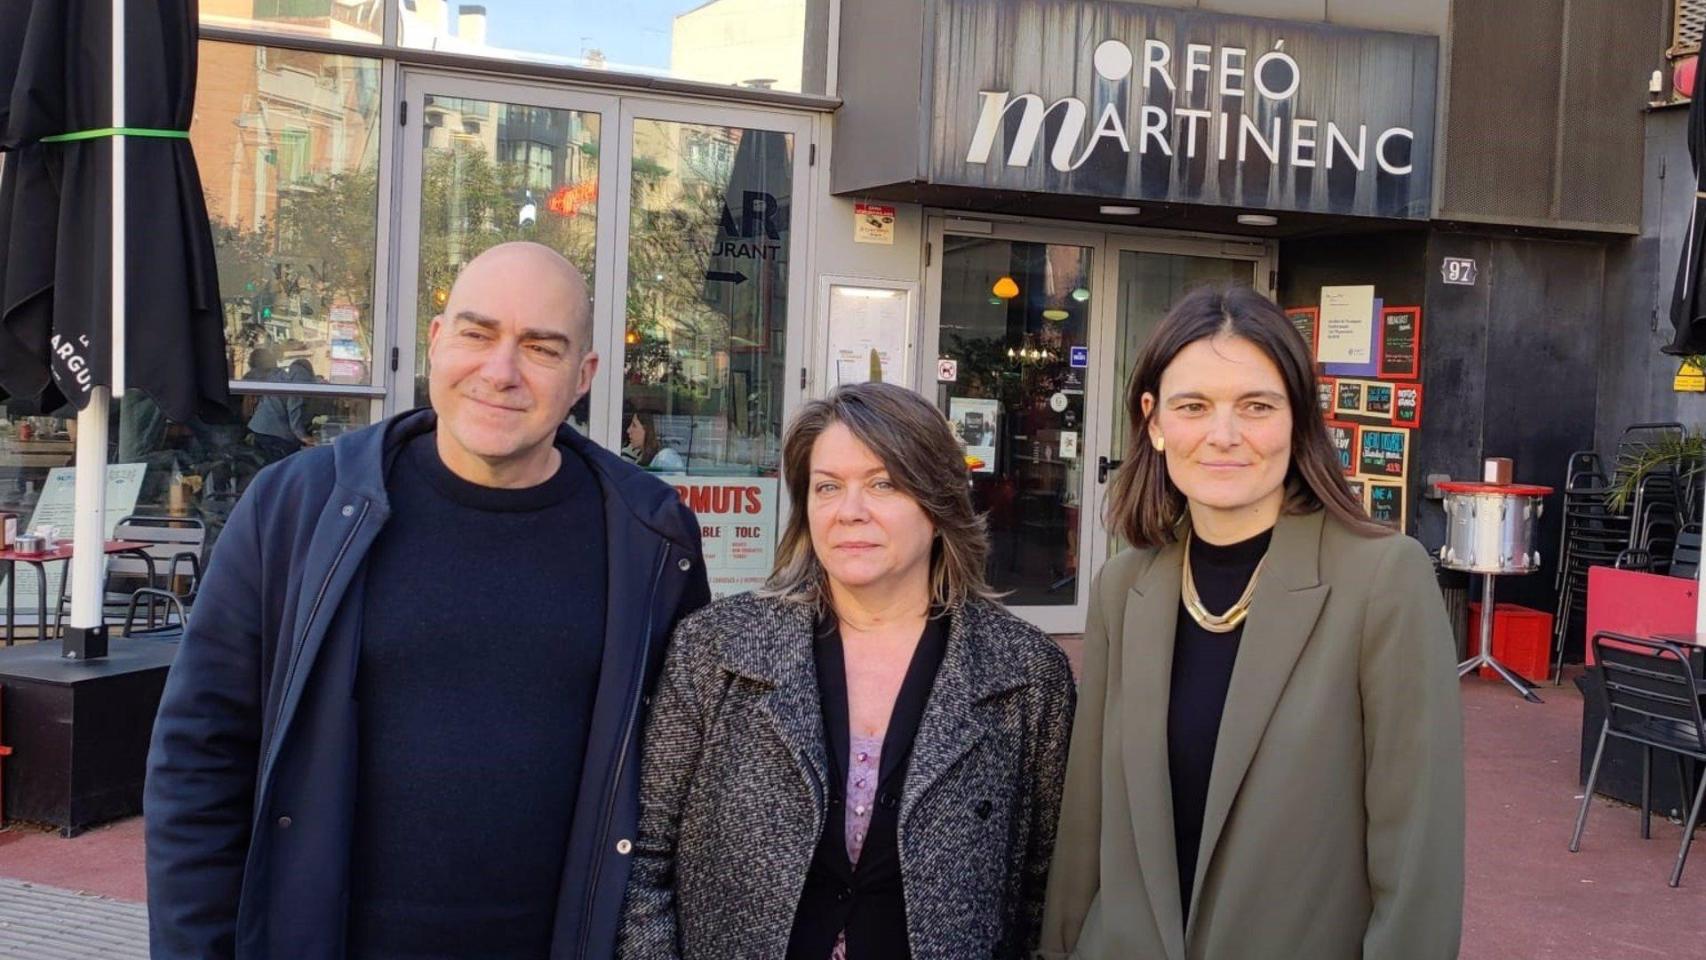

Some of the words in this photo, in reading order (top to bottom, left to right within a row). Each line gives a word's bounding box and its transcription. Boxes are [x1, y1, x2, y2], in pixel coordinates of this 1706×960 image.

[1094, 39, 1300, 100] ORFEÓ
[1449, 261, 1472, 282] 97
[700, 526, 721, 538] BLE
[734, 526, 761, 538] TOLC
